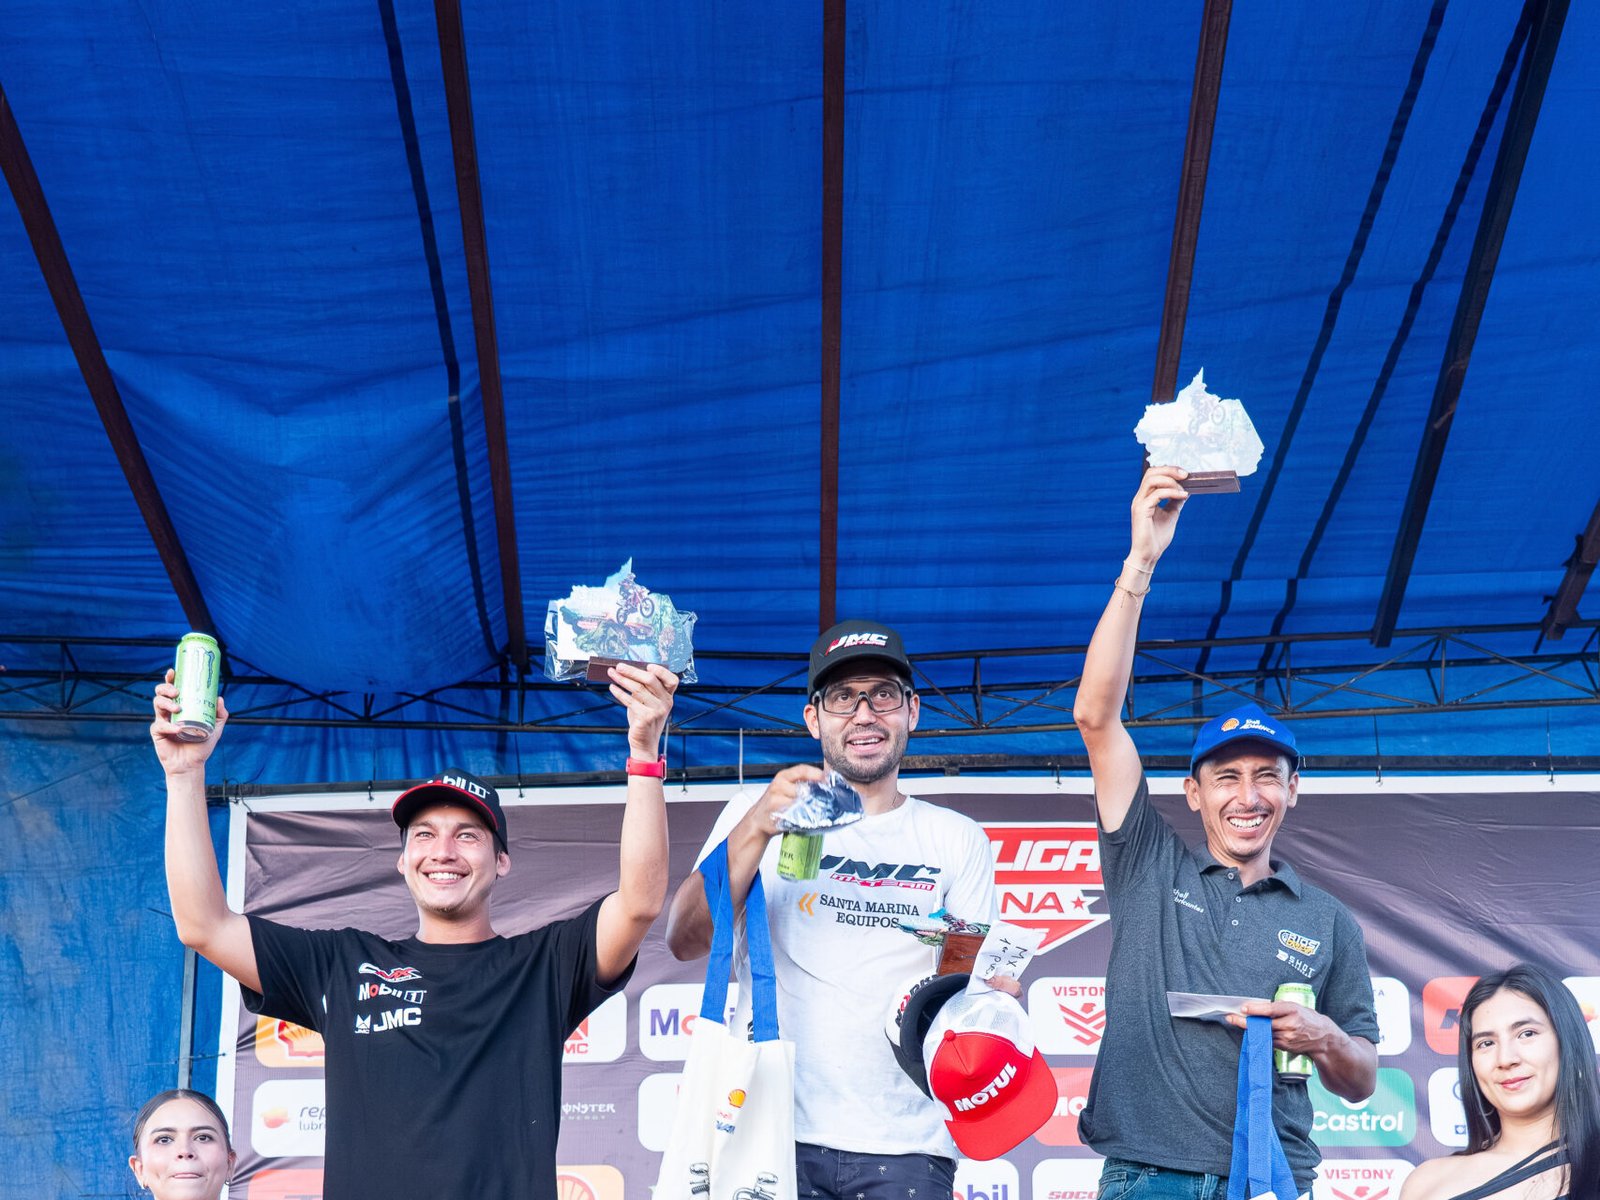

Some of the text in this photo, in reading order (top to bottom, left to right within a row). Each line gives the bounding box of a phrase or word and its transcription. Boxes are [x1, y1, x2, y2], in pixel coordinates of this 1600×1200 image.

[990, 840, 1100, 872] LIGA
[819, 894, 920, 917] SANTA MARINA
[835, 912, 900, 929] EQUIPOS
[358, 982, 403, 1001] Mobil
[373, 1007, 422, 1032] JMC
[564, 1043, 589, 1054] MC
[953, 1062, 1017, 1112] MOTUL
[562, 1102, 616, 1114] ONSTER
[1312, 1111, 1404, 1132] Castrol
[1324, 1169, 1394, 1180] VISTONY
